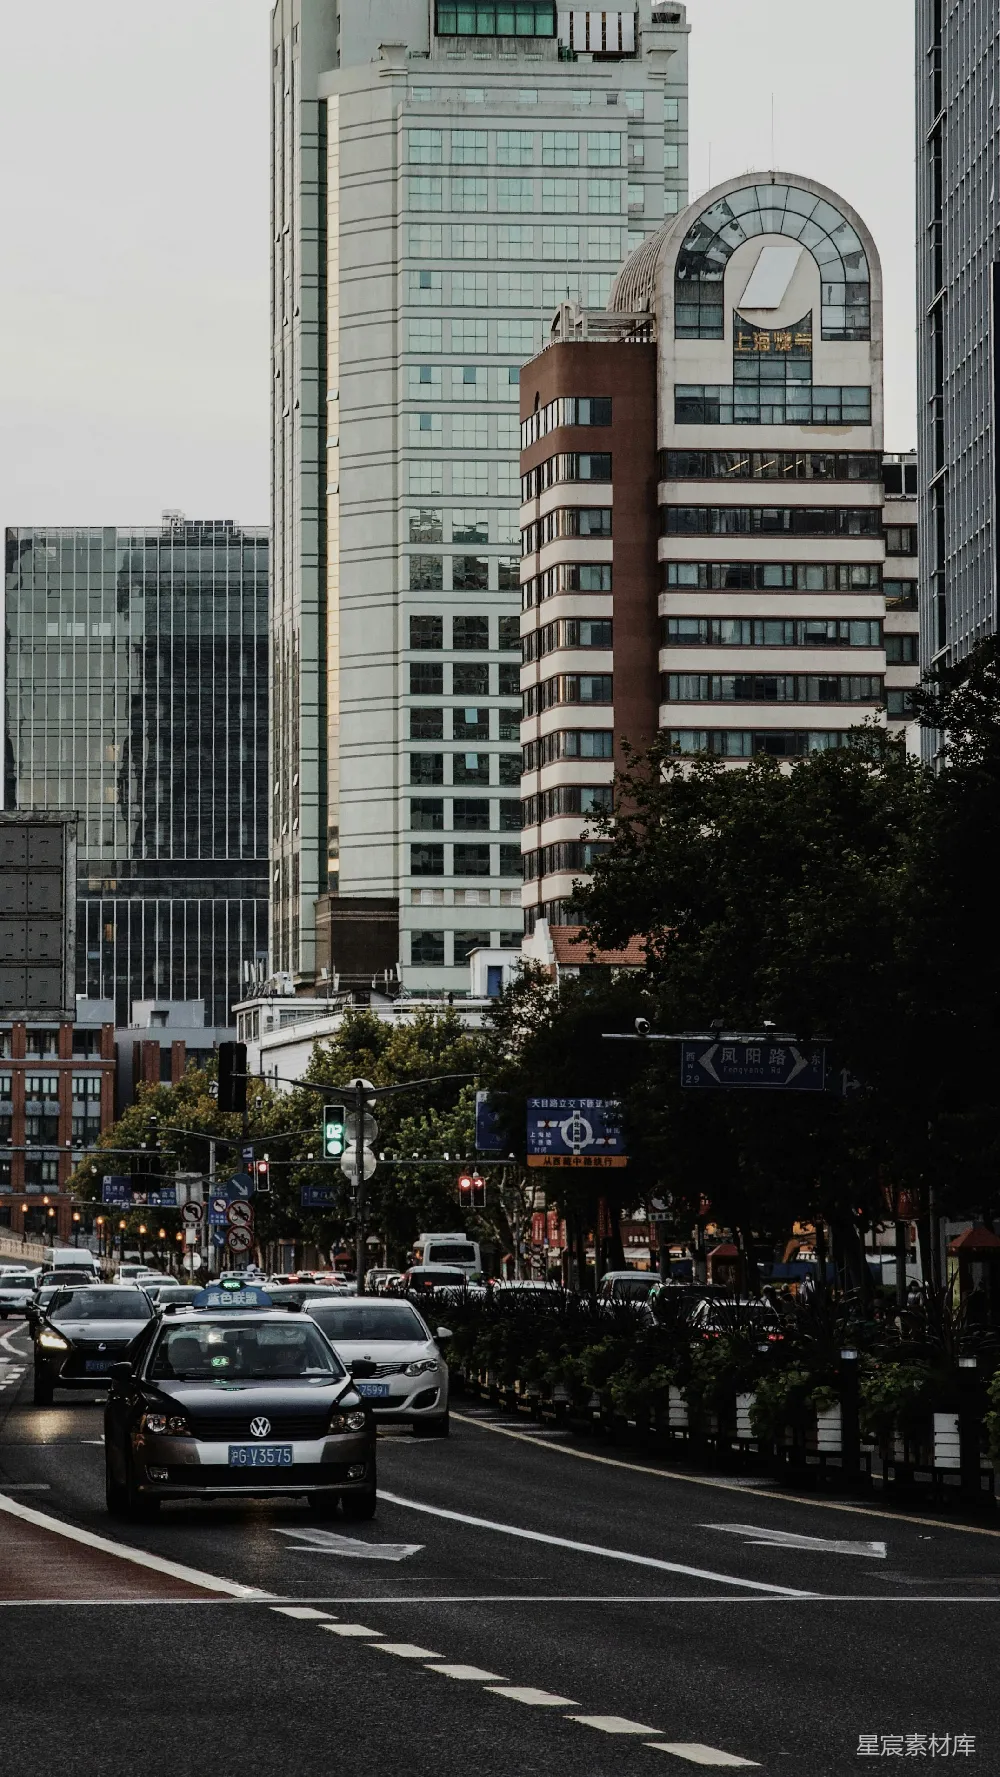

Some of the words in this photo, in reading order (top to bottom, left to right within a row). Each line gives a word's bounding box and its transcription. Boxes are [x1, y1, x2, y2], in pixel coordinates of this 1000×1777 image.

[686, 1051, 695, 1062] 西
[720, 1047, 786, 1066] 凤阳路
[811, 1053, 821, 1065] 东
[723, 1066, 764, 1075] Fengyang
[685, 1074, 700, 1084] 29
[544, 1156, 613, 1167] 从西藏中路绕行
[207, 1292, 258, 1305] 蓝色联盟
